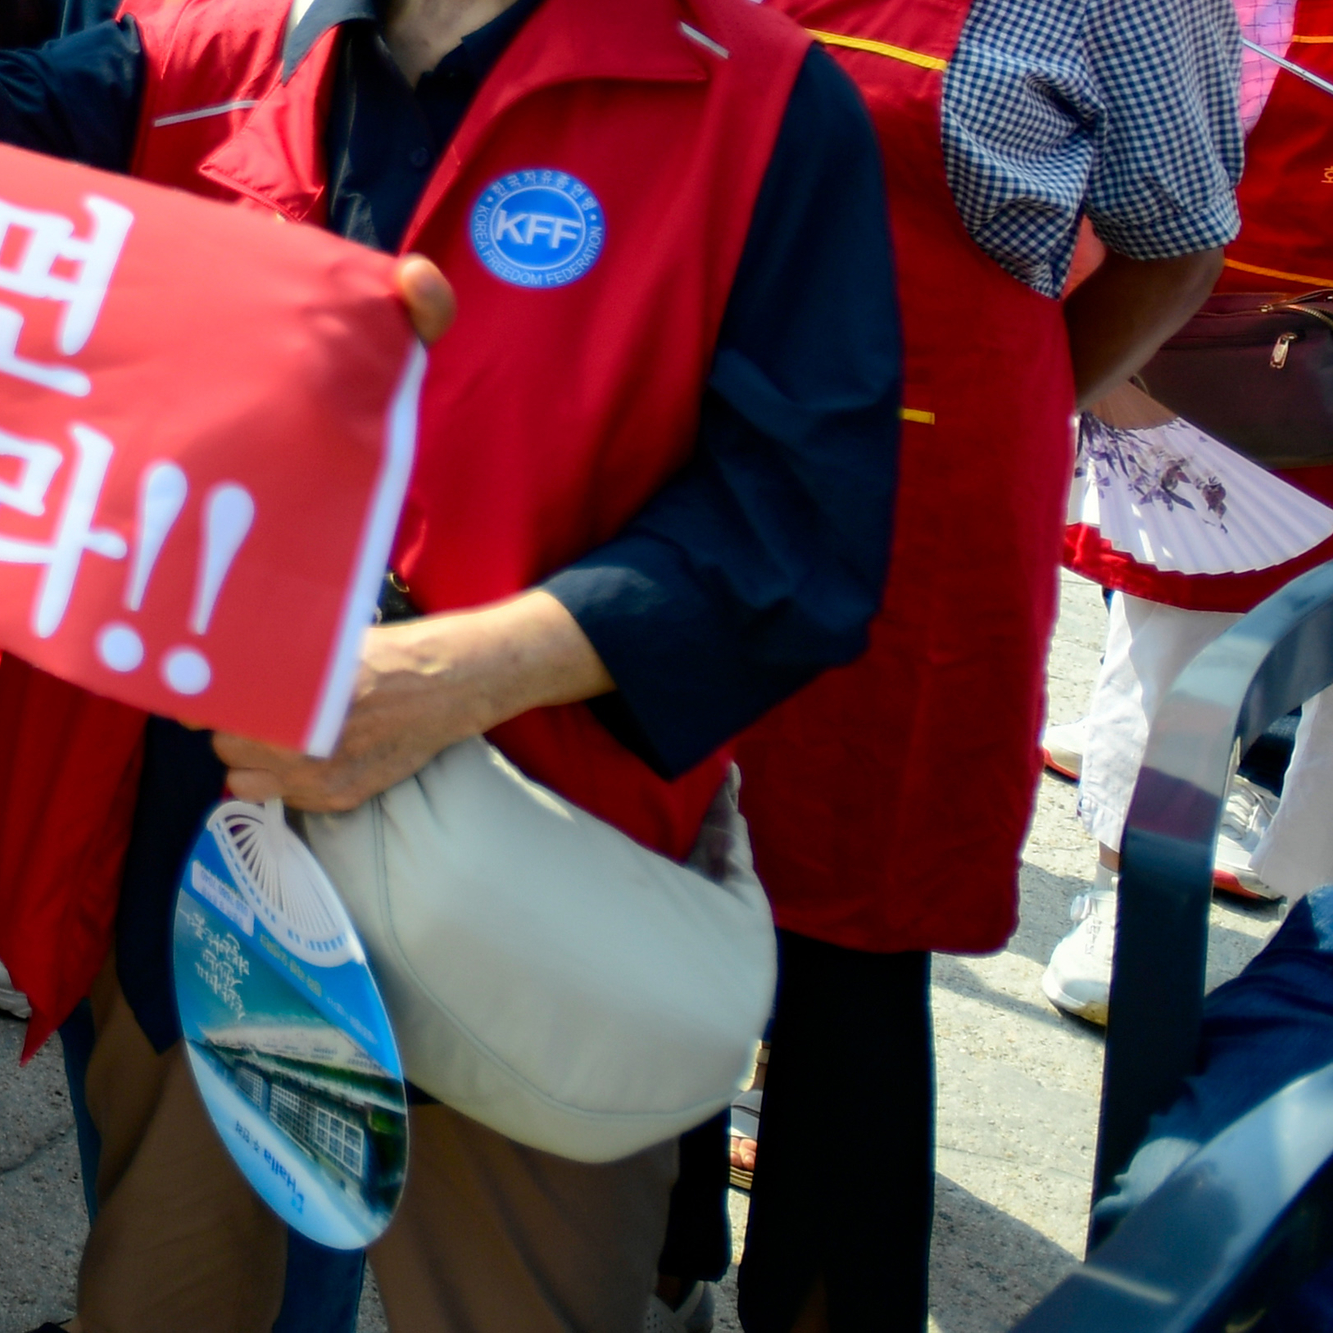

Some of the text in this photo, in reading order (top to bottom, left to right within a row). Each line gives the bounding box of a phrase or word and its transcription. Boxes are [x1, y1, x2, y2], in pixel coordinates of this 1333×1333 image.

[474, 203, 603, 286] KOREA FREEDOM FEDERATION
[495, 208, 583, 250] KFF
